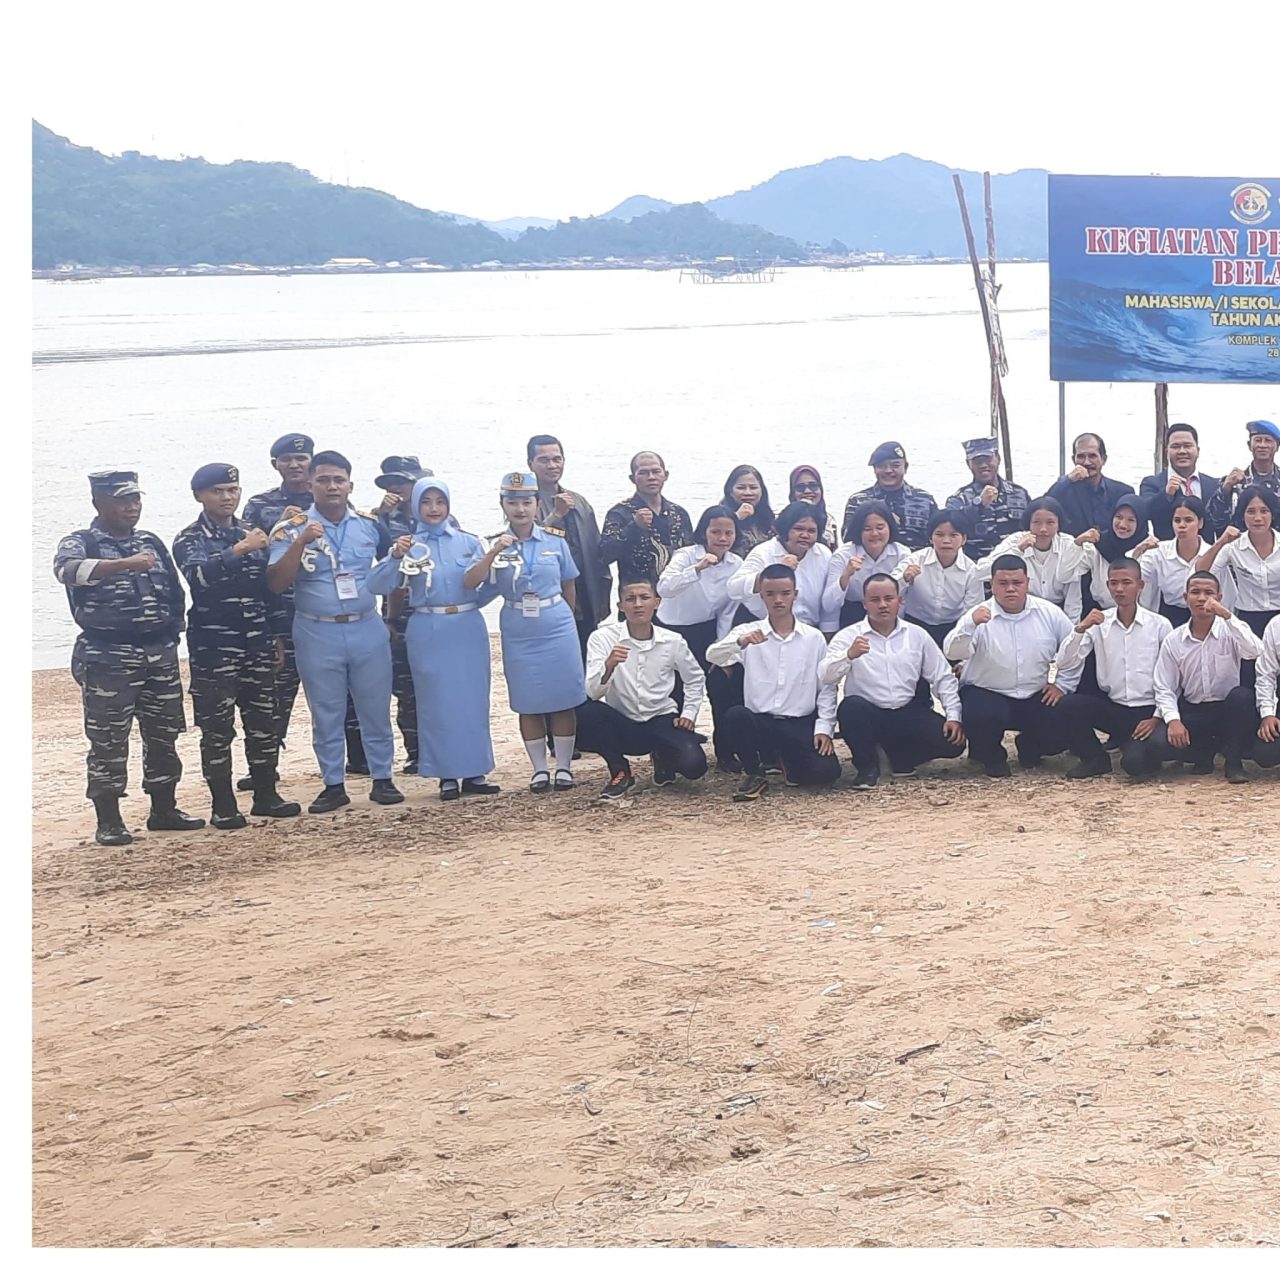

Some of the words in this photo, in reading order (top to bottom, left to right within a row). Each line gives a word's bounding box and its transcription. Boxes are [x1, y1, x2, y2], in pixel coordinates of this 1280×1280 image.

[1085, 227, 1238, 257] KEGIATAN
[1125, 294, 1228, 312] MAHASISWA/I
[1210, 312, 1261, 327] TAHUN
[1228, 335, 1277, 346] KOMPLEK
[1267, 348, 1280, 358] 28
